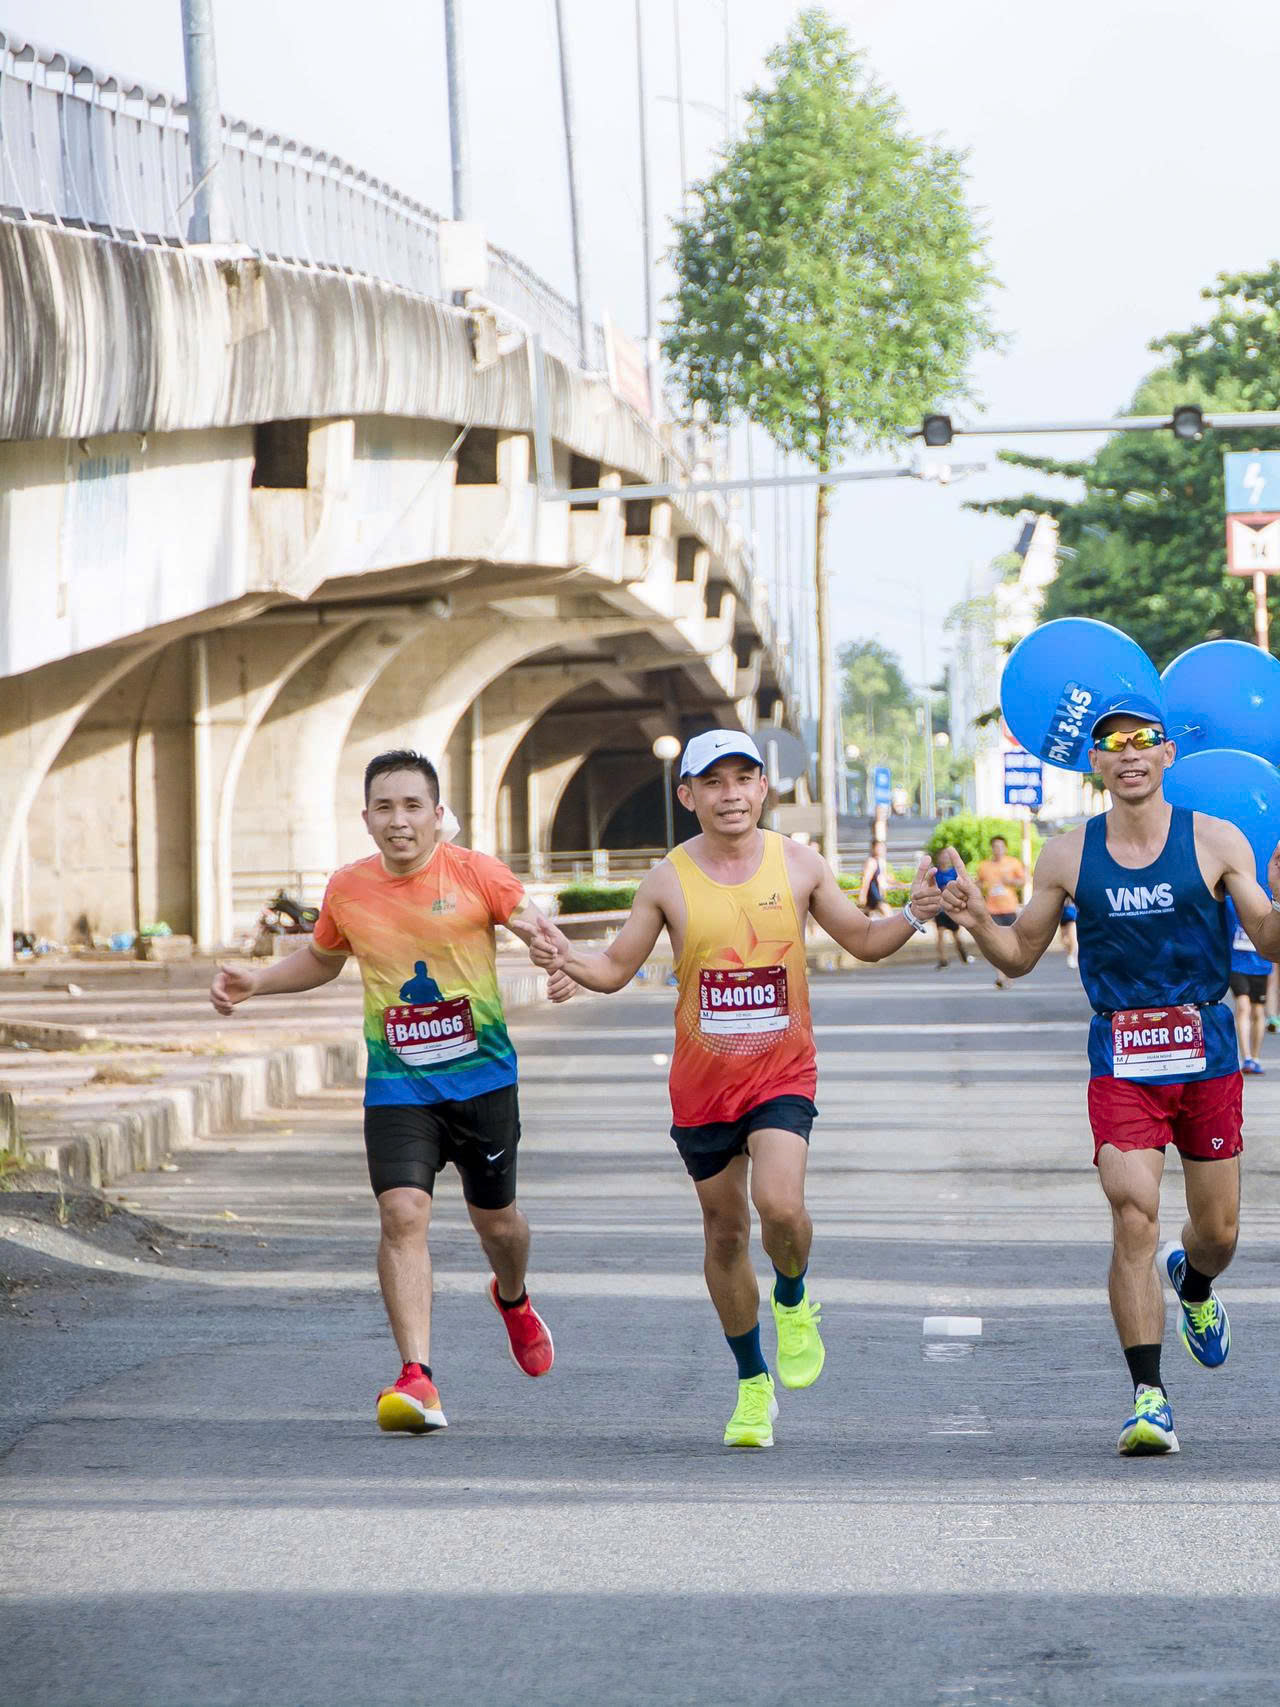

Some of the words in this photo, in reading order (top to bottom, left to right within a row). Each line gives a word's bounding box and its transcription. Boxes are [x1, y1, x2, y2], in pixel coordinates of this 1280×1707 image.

[1058, 688, 1092, 738] 3:45
[1048, 738, 1074, 763] FM
[1105, 883, 1174, 911] VNMS
[710, 984, 776, 1007] B40103
[395, 1015, 464, 1042] B40066
[1115, 1028, 1123, 1054] 42KM
[1123, 1028, 1170, 1048] PACER
[1173, 1025, 1193, 1043] 03
